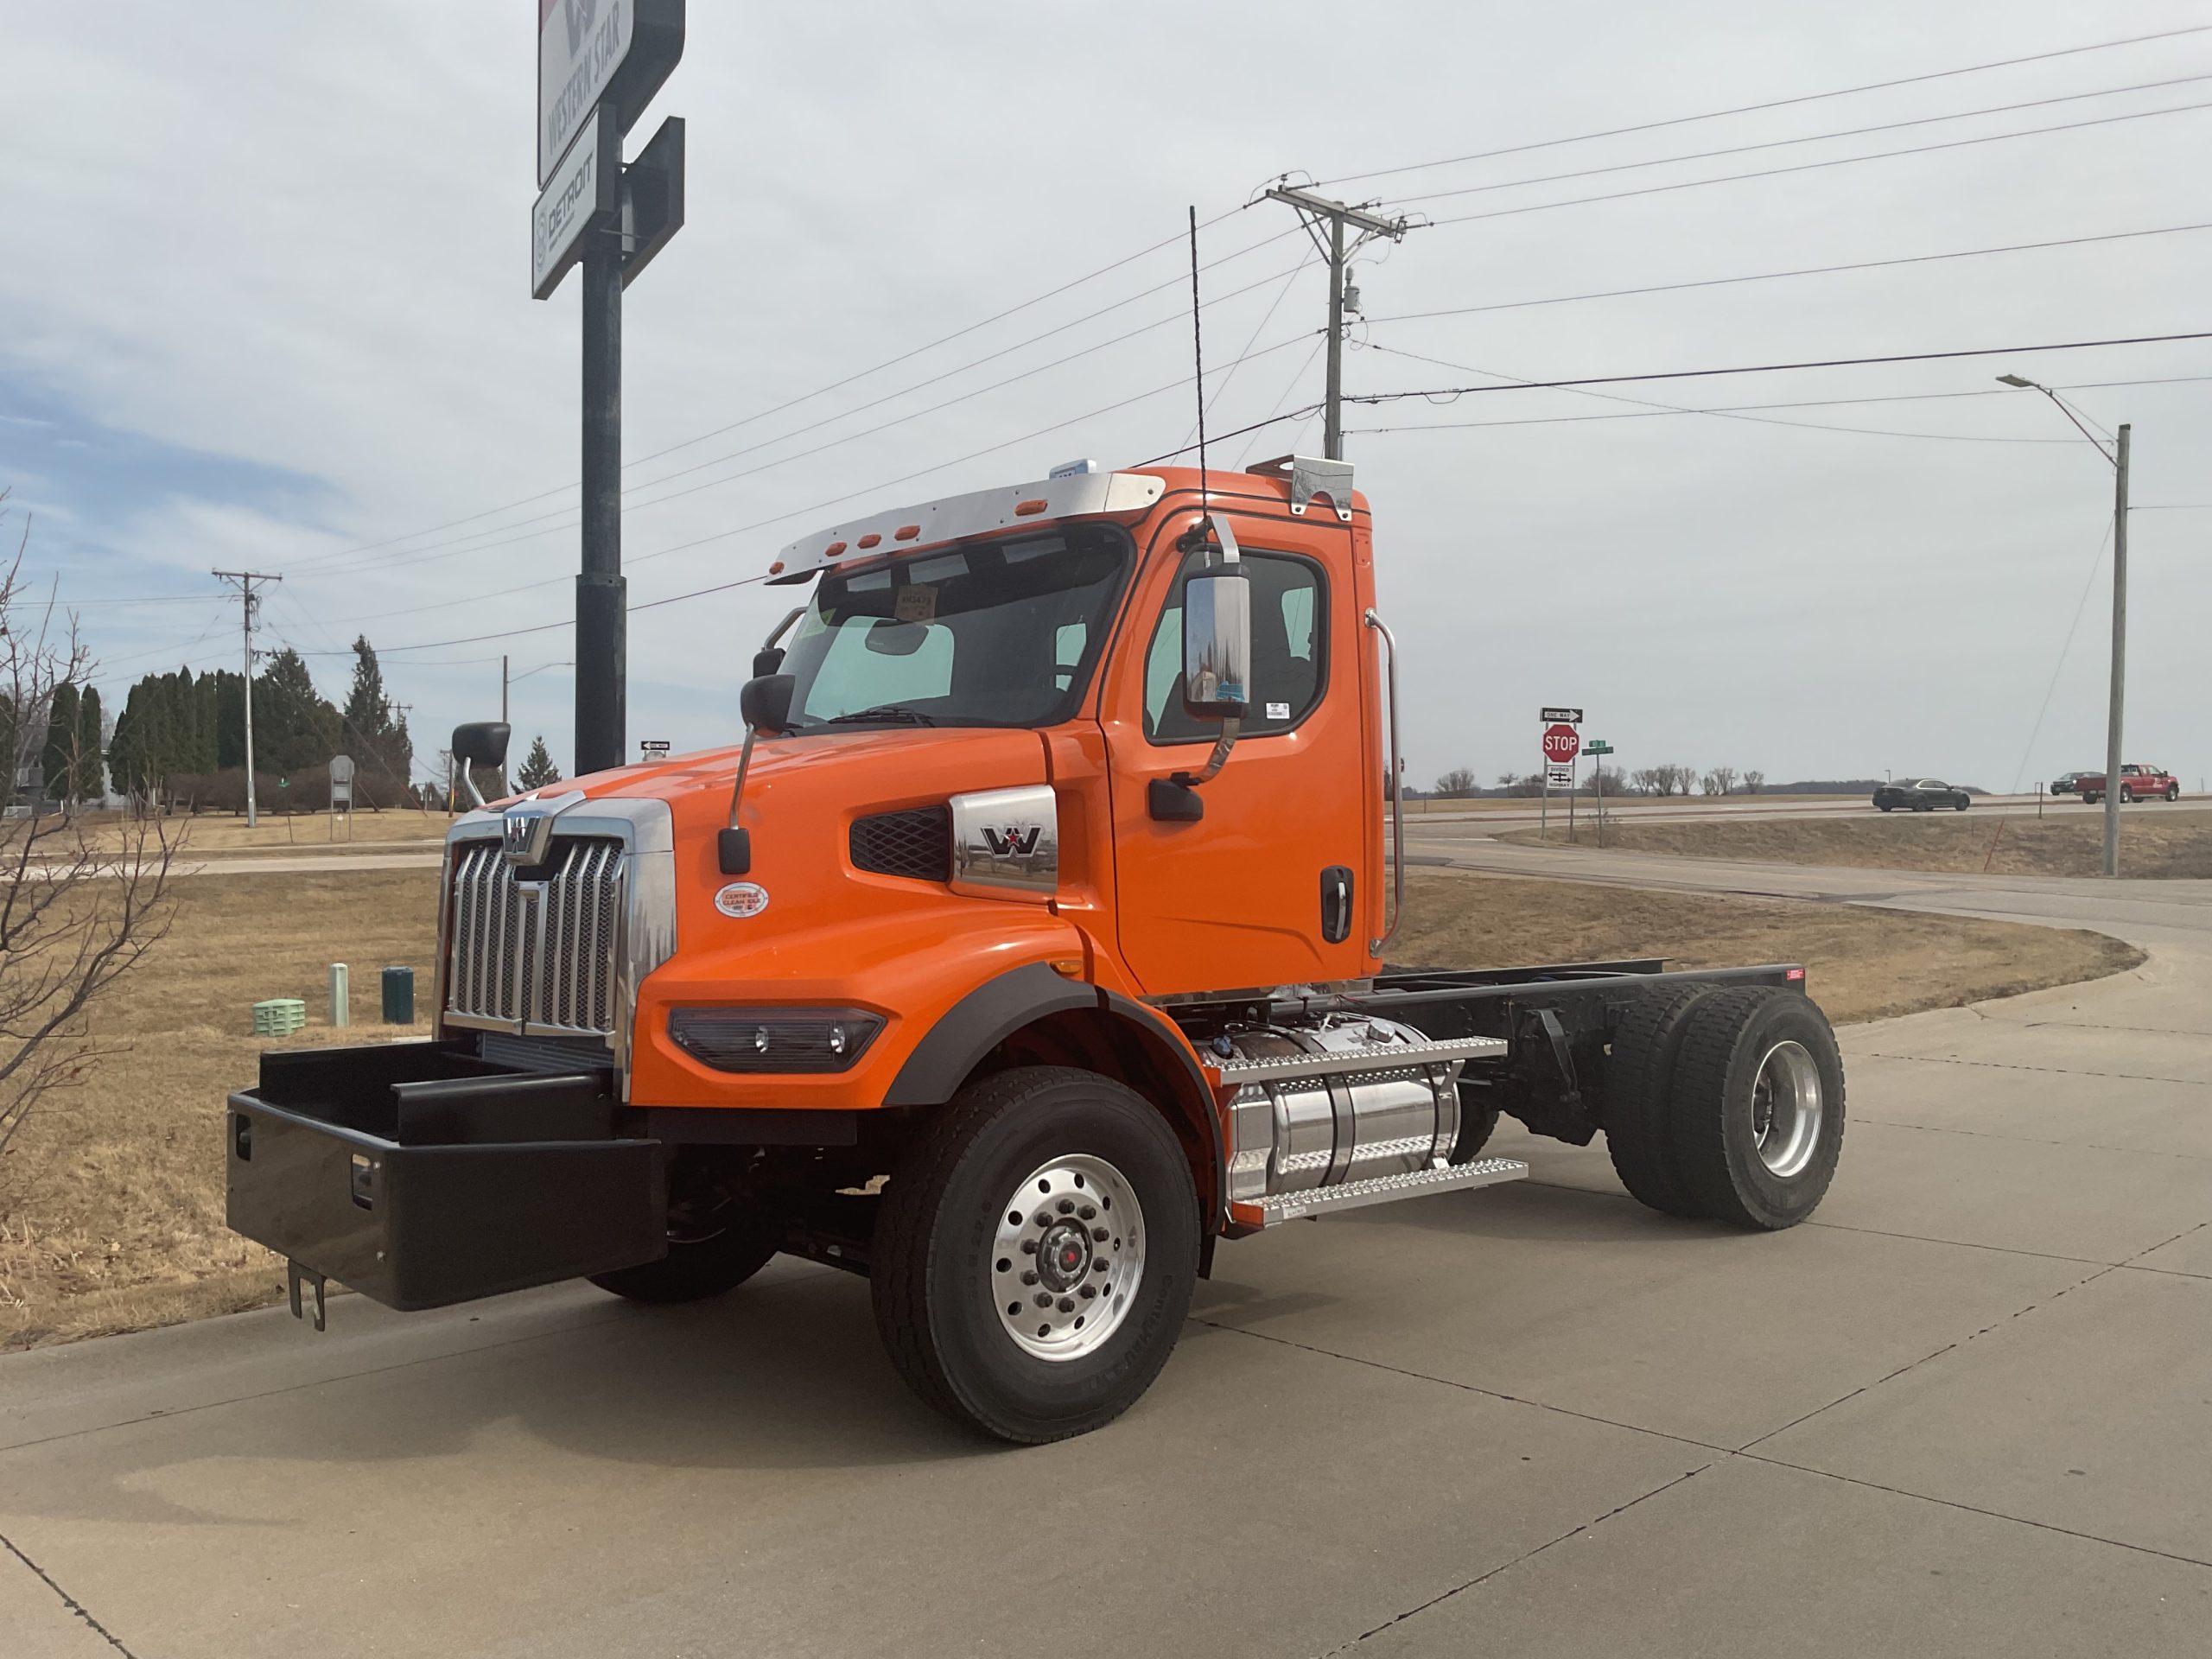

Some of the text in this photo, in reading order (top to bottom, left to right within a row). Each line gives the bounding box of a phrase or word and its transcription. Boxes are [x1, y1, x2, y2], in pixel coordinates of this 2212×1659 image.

[548, 1, 620, 156] WESTERN STAR
[549, 149, 594, 239] DETROIT
[1545, 735, 1577, 751] STOP
